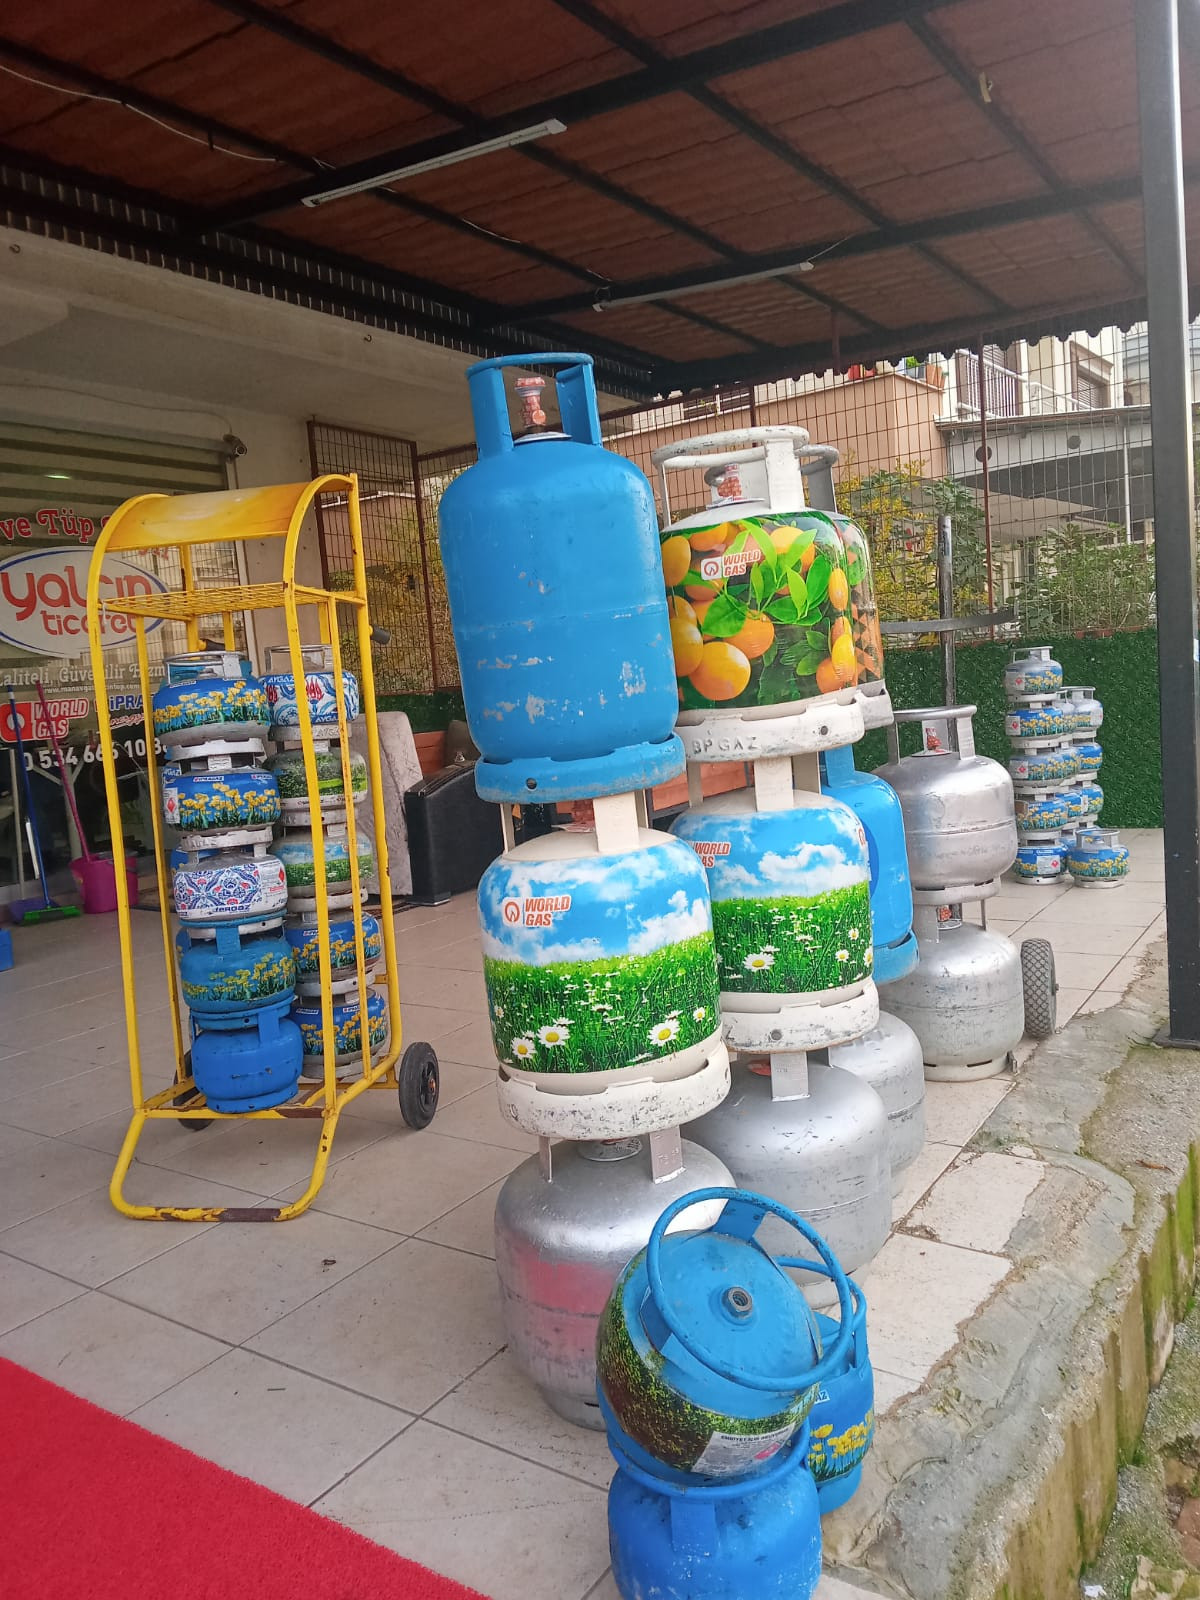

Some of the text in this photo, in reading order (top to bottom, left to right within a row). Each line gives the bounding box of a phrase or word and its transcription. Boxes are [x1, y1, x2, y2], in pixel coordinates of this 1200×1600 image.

[37, 508, 95, 543] Tüp
[723, 550, 760, 566] WORLD
[724, 564, 746, 576] GAS
[60, 663, 125, 682] Güveilir
[34, 698, 87, 719] WORLD
[37, 719, 67, 738] GAS
[718, 736, 758, 752] GAZ
[694, 842, 730, 855] WORLD
[701, 855, 715, 868] AS
[525, 896, 571, 912] WORLD
[525, 913, 552, 926] GAS
